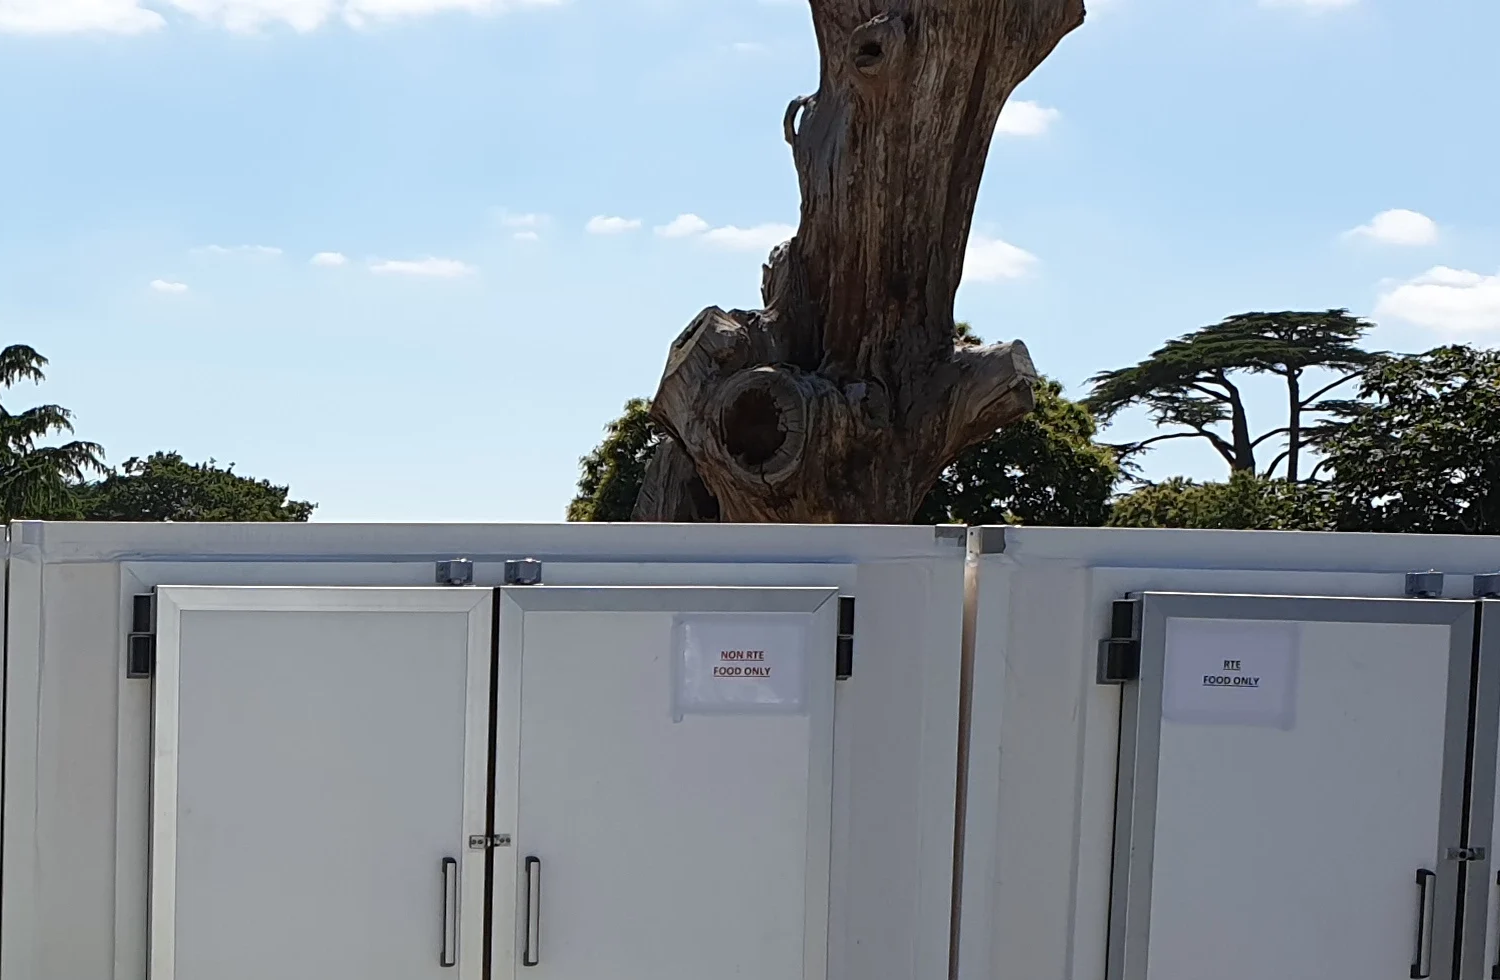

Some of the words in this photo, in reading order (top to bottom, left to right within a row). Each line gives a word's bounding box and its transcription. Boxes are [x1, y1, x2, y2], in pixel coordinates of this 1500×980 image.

[720, 650, 744, 660] NON
[746, 650, 765, 660] RTE
[1223, 659, 1241, 670] RTE
[713, 666, 742, 677] FOOD
[744, 666, 771, 677] ONLY
[1203, 675, 1231, 686] FOOD
[1233, 676, 1260, 687] ONLY
